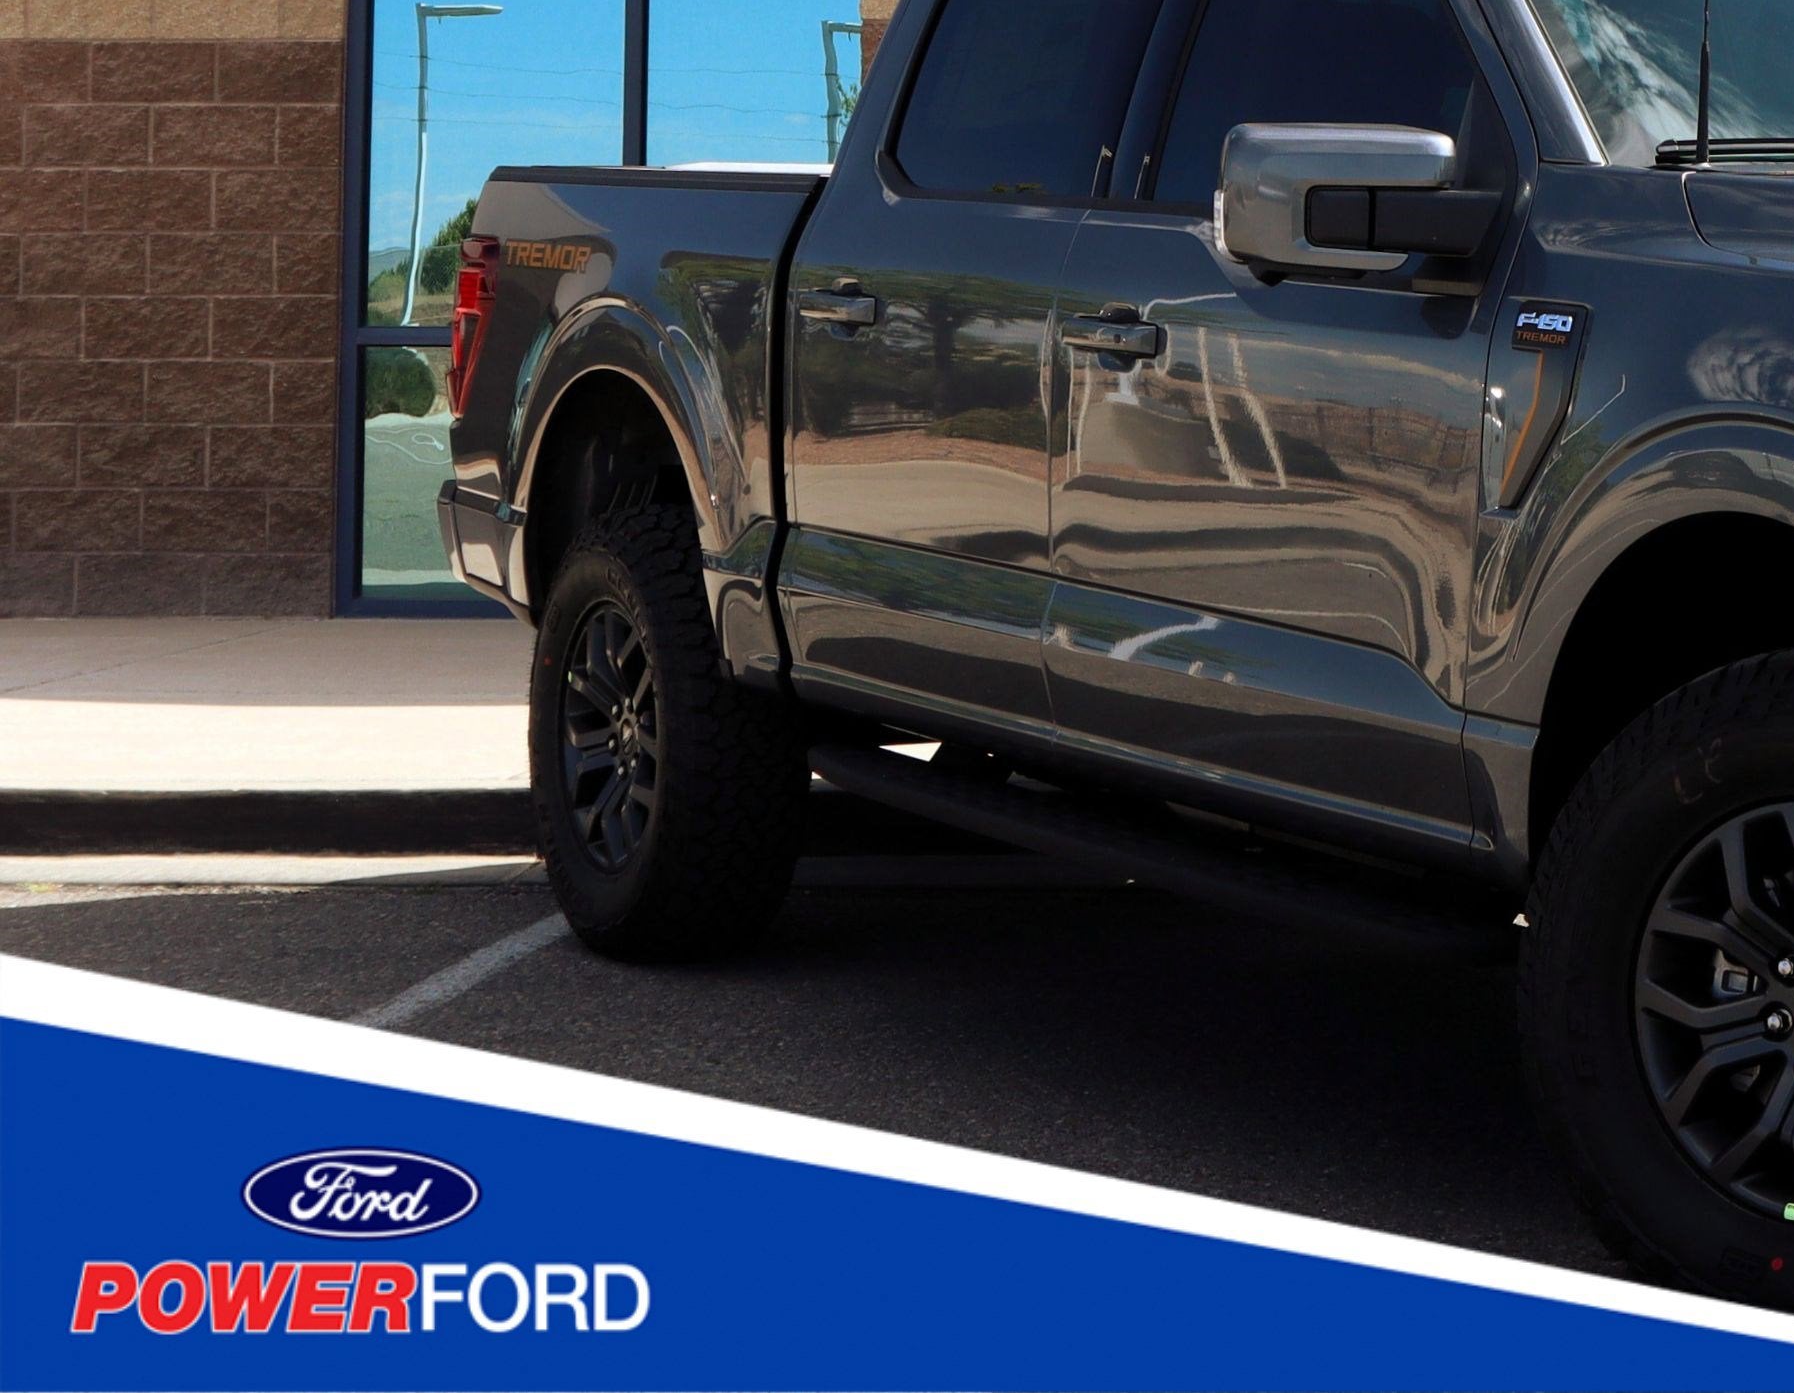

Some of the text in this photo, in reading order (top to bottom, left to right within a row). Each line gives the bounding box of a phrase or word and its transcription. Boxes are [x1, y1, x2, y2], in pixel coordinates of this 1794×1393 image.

[504, 238, 592, 274] TREMOR
[1516, 311, 1573, 333] F-150
[1515, 330, 1567, 346] TREMOR
